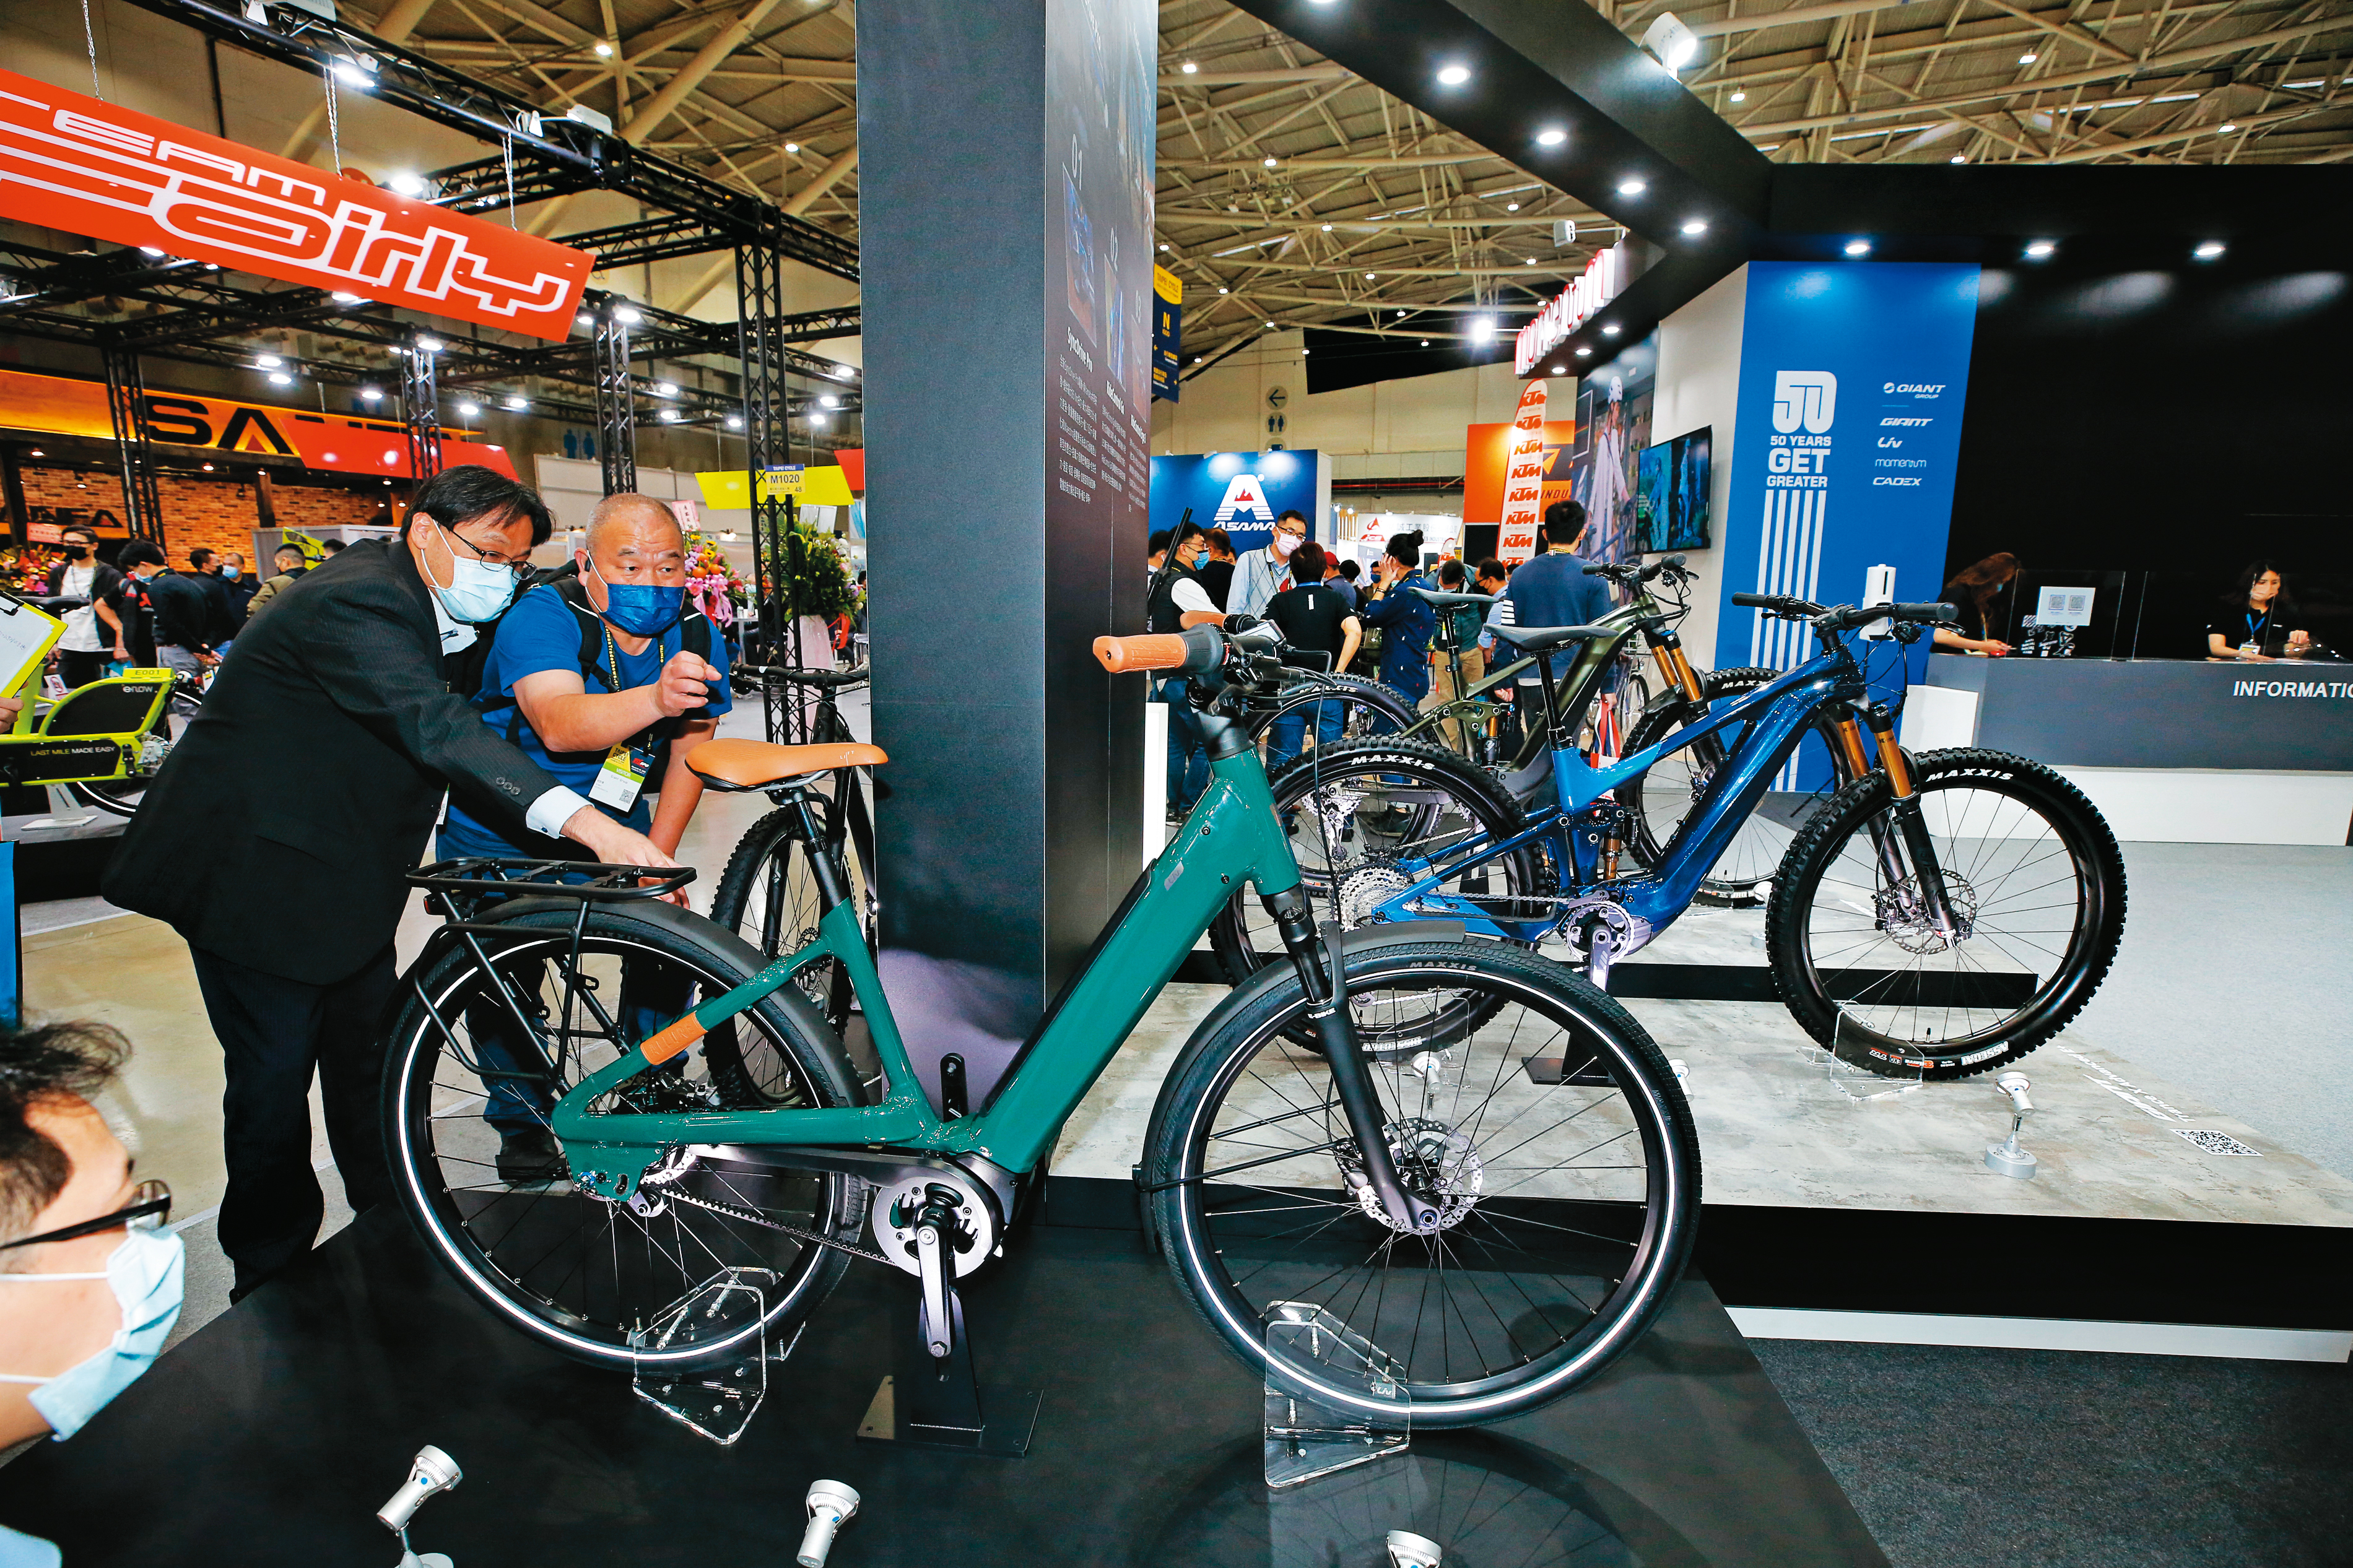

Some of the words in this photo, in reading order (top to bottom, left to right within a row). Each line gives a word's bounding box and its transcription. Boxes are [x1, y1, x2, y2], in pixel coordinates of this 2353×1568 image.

[1163, 312, 1170, 329] N
[1897, 384, 1946, 393] GIANT
[1520, 390, 1547, 408] KTM
[1516, 415, 1542, 430] KTM
[1880, 418, 1933, 427] GIANT
[1514, 439, 1543, 455] KTM
[1770, 435, 1787, 446] 50
[1789, 436, 1832, 446] YEARS
[1877, 437, 1903, 448] Liv
[1768, 448, 1830, 473] GET
[1875, 459, 1926, 467] momentum
[1511, 463, 1541, 479] KTM
[770, 474, 799, 483] M1020
[1767, 476, 1828, 487] GREATER
[1872, 477, 1922, 486] CADEX
[1508, 487, 1539, 502] KTM
[1541, 489, 1570, 500] INDU
[1505, 511, 1536, 525] KTM
[1213, 521, 1276, 531] ASAMA
[1503, 534, 1533, 547] KTM
[1351, 754, 1435, 770] MAXXIS
[616, 768, 631, 778] VISITOR
[1926, 768, 2014, 783] MAXXIS
[1409, 961, 1477, 971] MAXXIS
[1308, 1007, 1337, 1020] E-BIKE
[2067, 1053, 2136, 1088] Advanced
[2144, 1094, 2196, 1122] Trance
[1377, 1387, 1392, 1395] Liv
